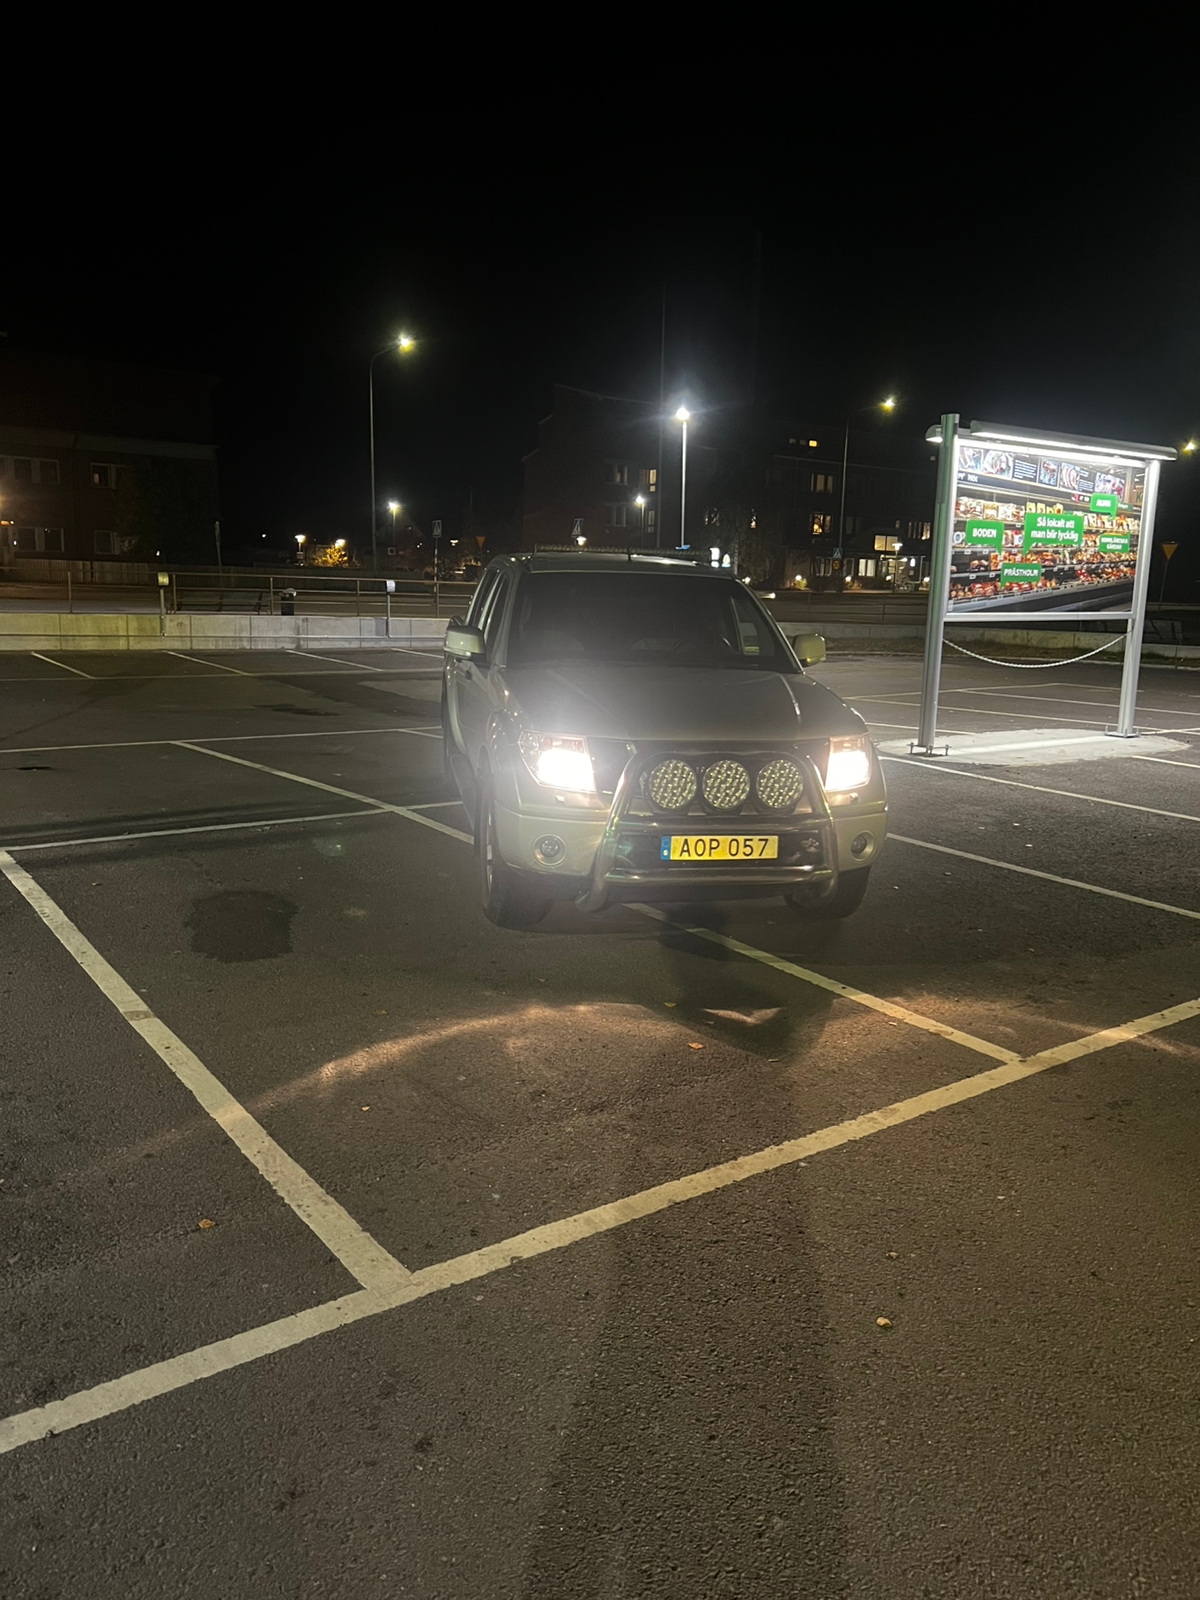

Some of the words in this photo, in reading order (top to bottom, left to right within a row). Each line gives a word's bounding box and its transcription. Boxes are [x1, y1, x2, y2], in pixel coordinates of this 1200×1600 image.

[1037, 517, 1046, 526] Så
[1046, 518, 1065, 528] lokalt
[1066, 520, 1074, 528] att
[972, 528, 996, 538] BODEN
[1046, 530, 1057, 538] blir
[1058, 530, 1078, 542] lycklig
[680, 838, 720, 857] AOP
[728, 838, 769, 857] 057
